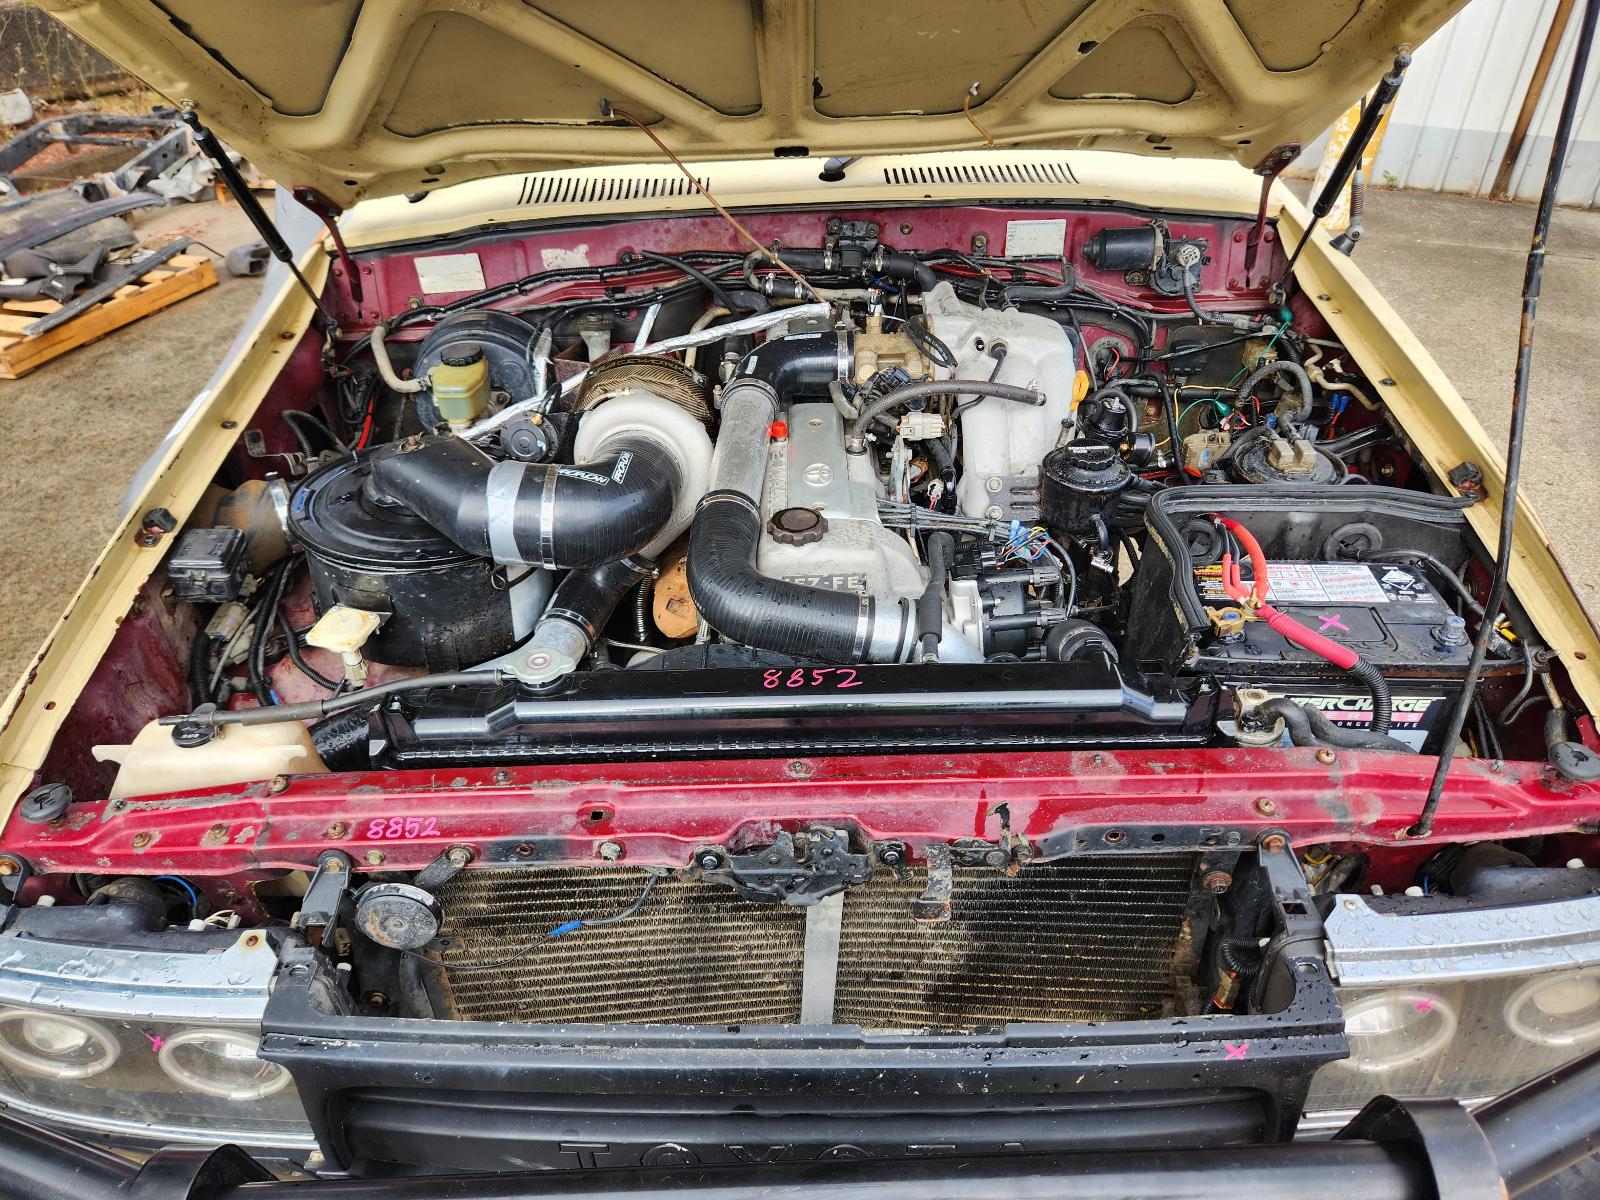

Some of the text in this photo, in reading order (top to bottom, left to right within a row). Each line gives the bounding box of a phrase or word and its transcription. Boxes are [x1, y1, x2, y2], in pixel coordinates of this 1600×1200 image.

[559, 468, 607, 483] ROFLOW
[784, 576, 862, 590] FZ-FE
[763, 667, 864, 689] 8852
[366, 816, 441, 839] 8852
